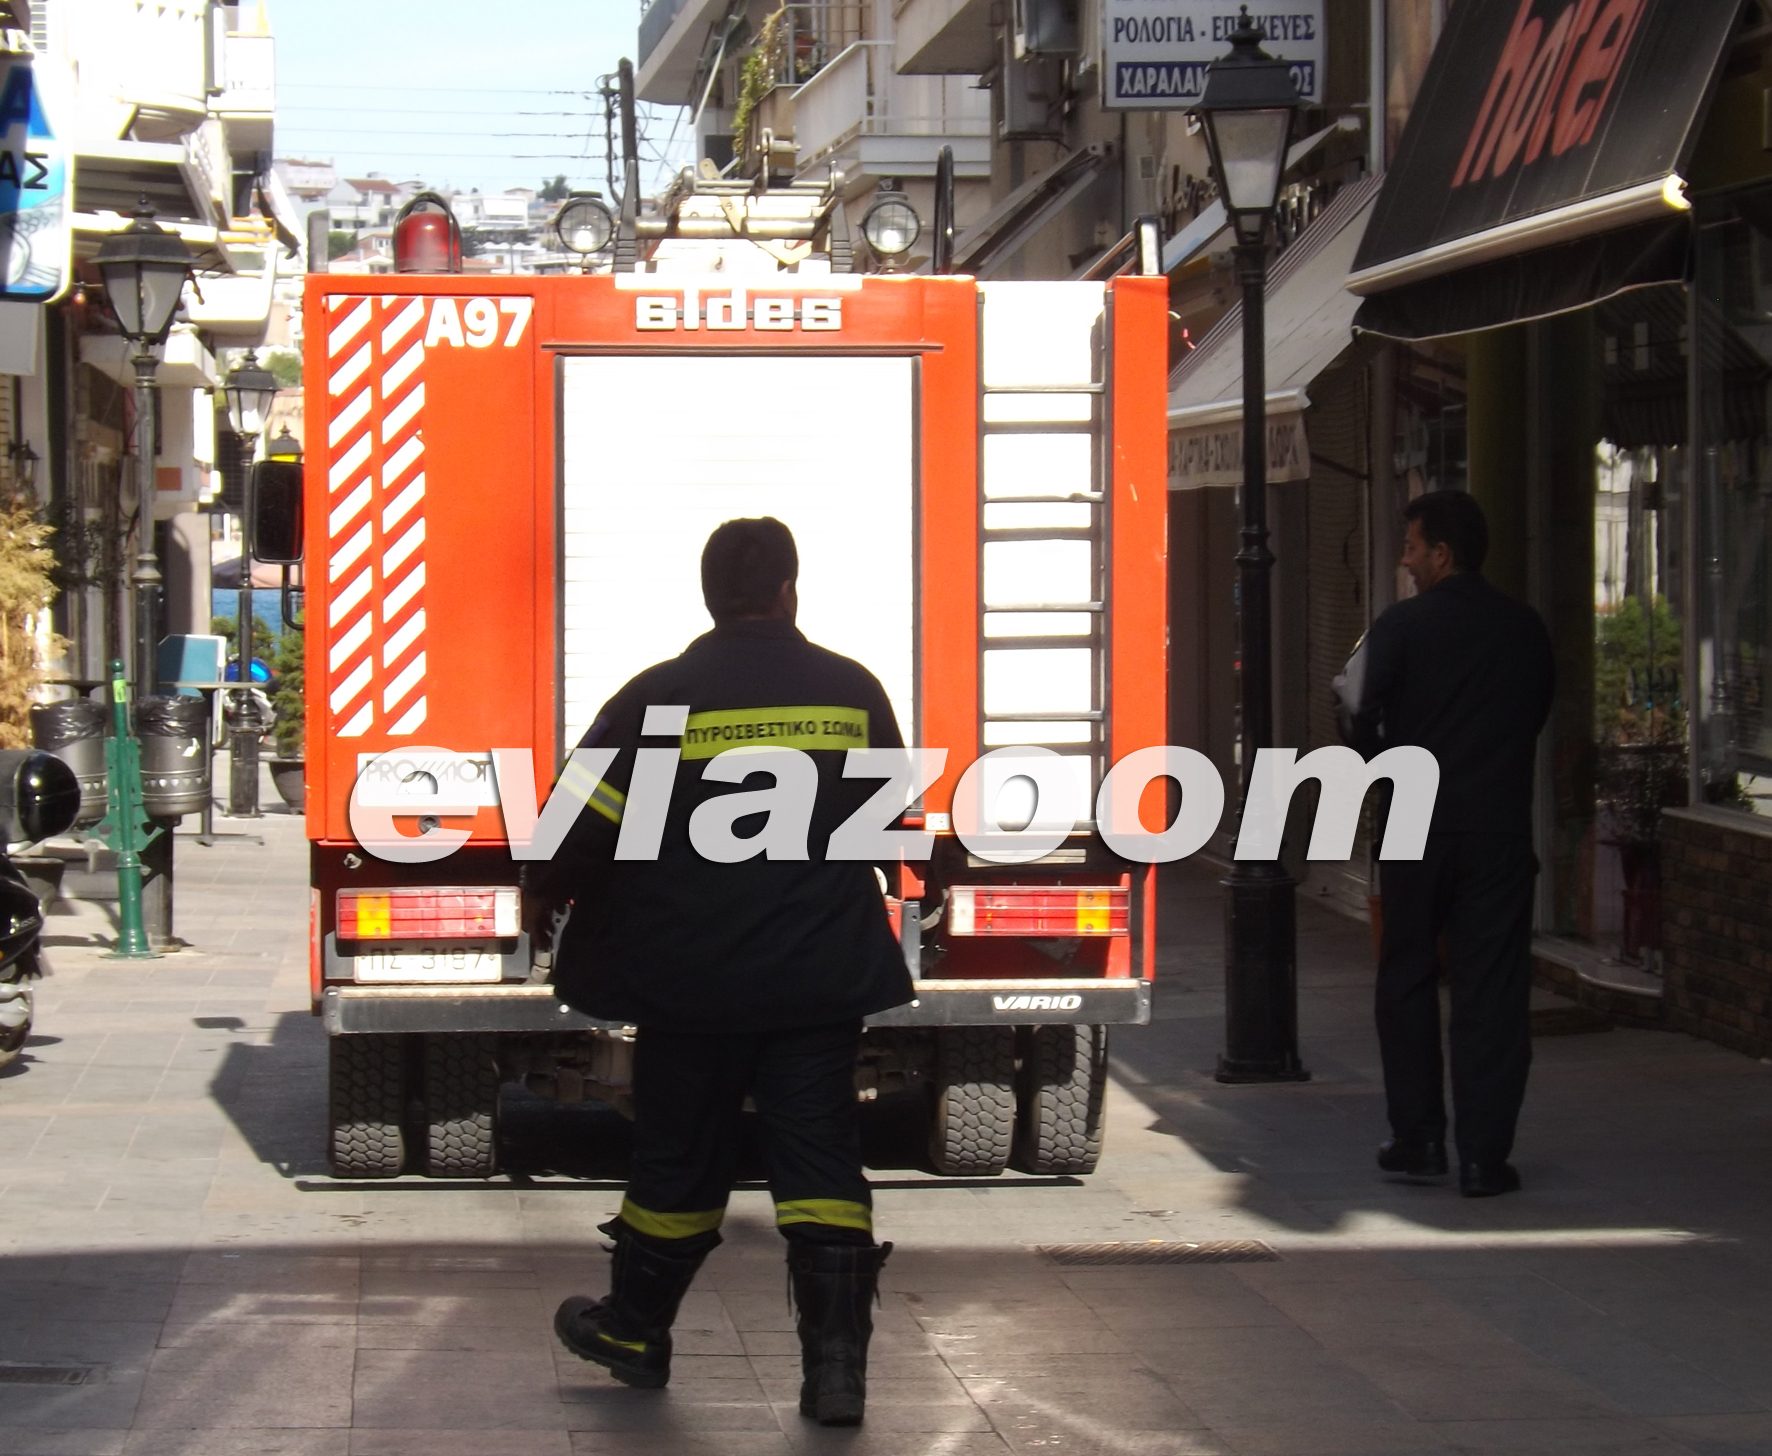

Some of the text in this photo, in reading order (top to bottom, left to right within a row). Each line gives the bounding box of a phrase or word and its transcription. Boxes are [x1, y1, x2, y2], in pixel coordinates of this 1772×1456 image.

[1113, 15, 1315, 42] ΡΟΛΟΓΙΑ ΕΠΚΕΥΕΣ
[1450, 0, 1649, 188] hotel
[424, 297, 532, 348] A97
[686, 719, 864, 744] ΠΥΡΟΣΒΕΣΤΙΚΟ ΣΩΜΑ
[993, 994, 1082, 1011] VARIO
